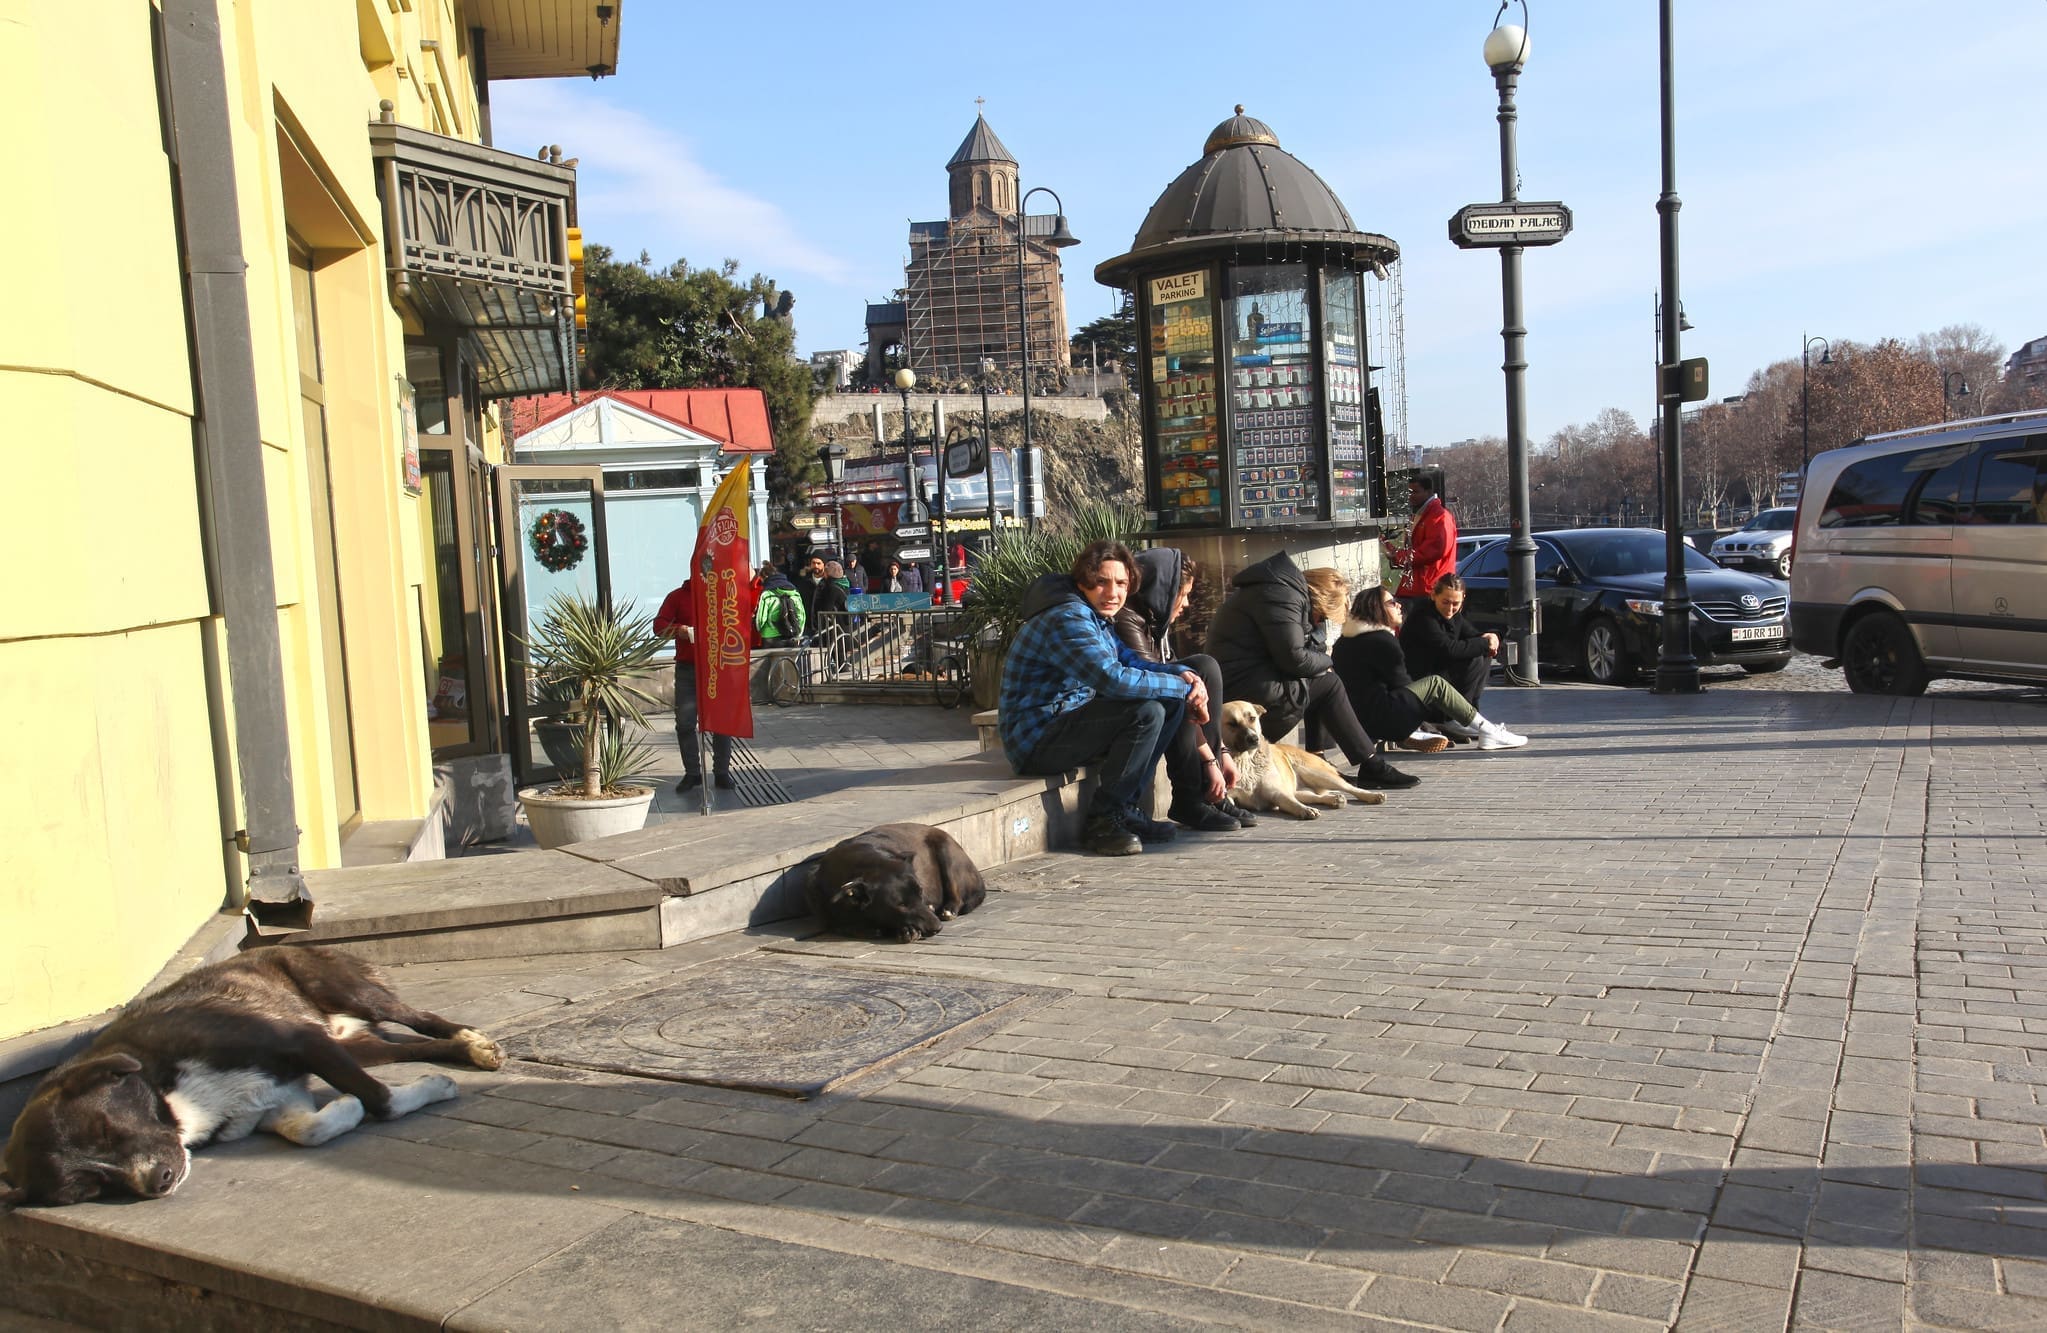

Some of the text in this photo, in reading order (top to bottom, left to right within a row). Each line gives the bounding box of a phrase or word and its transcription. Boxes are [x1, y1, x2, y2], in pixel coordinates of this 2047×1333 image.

[1468, 216, 1563, 229] MEIDAN PALACE
[1156, 273, 1199, 291] VALET
[1160, 287, 1196, 301] PARKING
[1742, 626, 1782, 639] 10 RR 110
